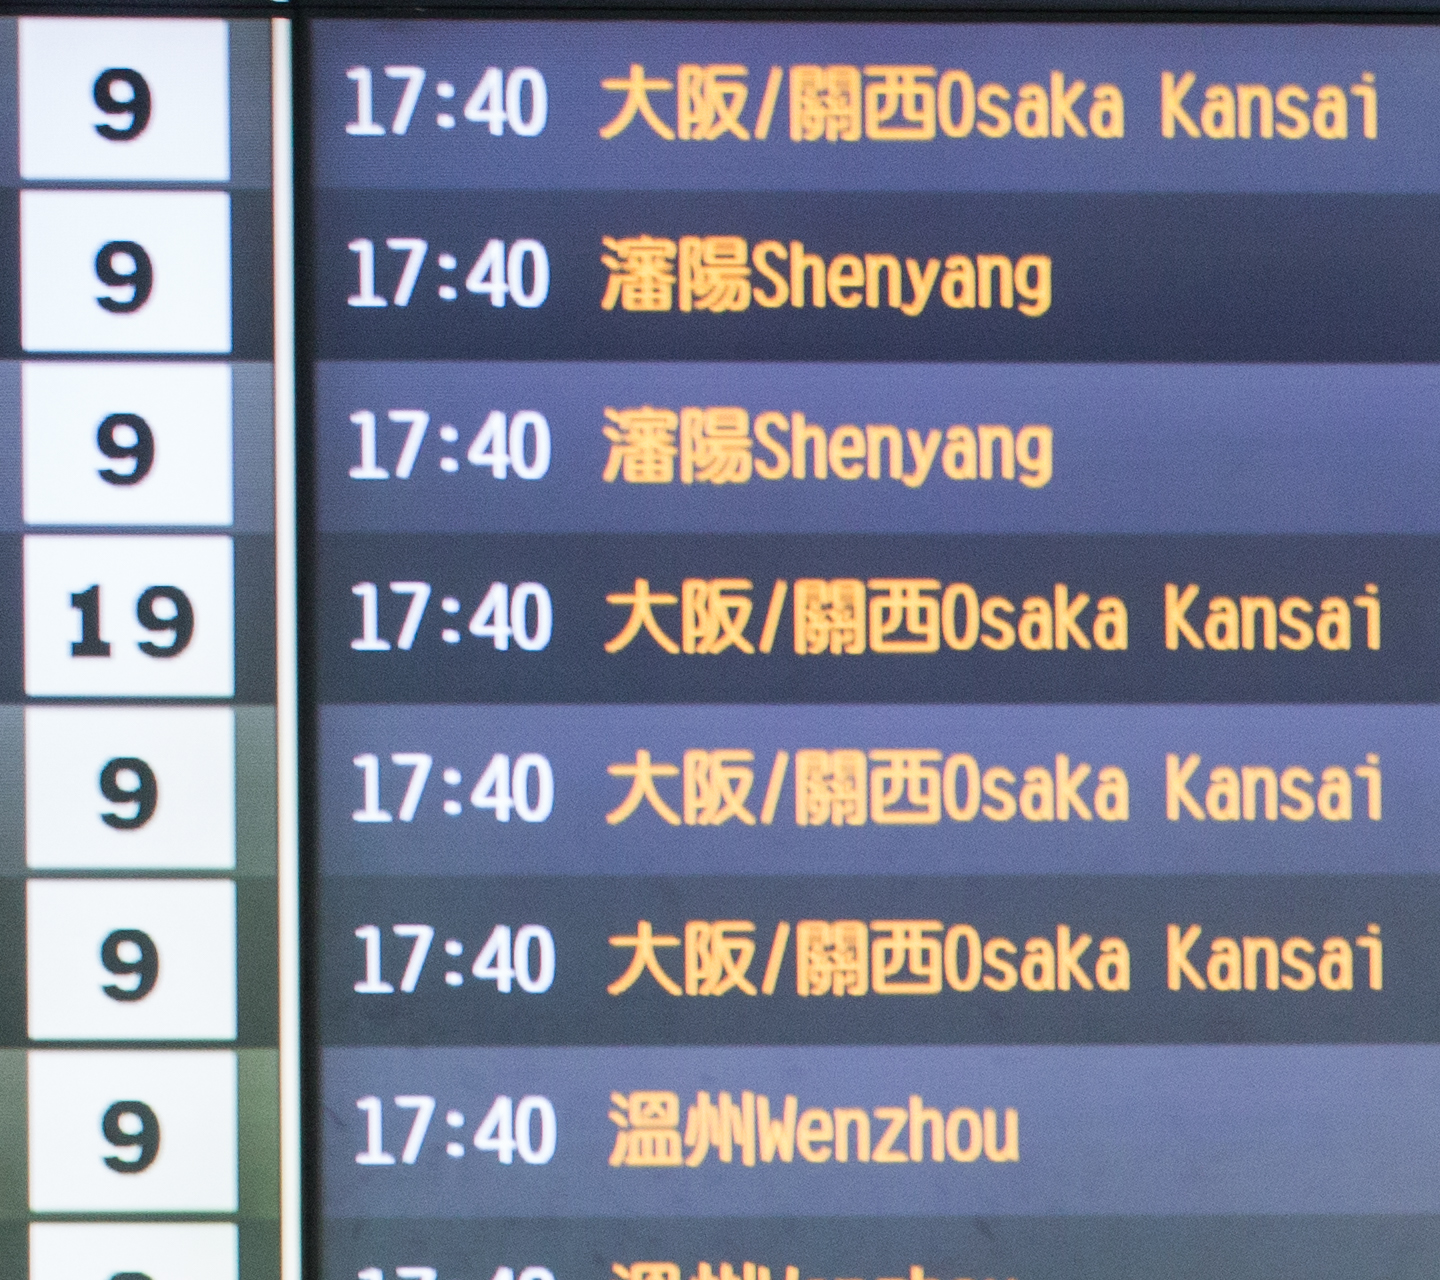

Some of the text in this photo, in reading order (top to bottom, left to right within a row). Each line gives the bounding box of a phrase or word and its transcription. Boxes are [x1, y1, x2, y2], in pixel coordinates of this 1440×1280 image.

[92, 67, 153, 143] 9
[345, 65, 548, 137] 17:40
[1160, 71, 1378, 140] Kansai
[93, 239, 154, 315] 9
[347, 238, 550, 308] 17:40
[95, 412, 156, 487] 9
[348, 409, 552, 481] 17:40
[70, 584, 195, 659] 19
[350, 581, 553, 652] 17:40
[1163, 582, 1382, 652] Kansai
[98, 756, 159, 831] 9
[352, 752, 555, 824] 17:40
[1165, 754, 1382, 822] Kansai
[100, 928, 160, 1003] 9
[353, 923, 556, 994] 17:40
[1165, 922, 1383, 992] Kansai
[101, 1099, 161, 1175] 9
[354, 1094, 558, 1166] 17:40
